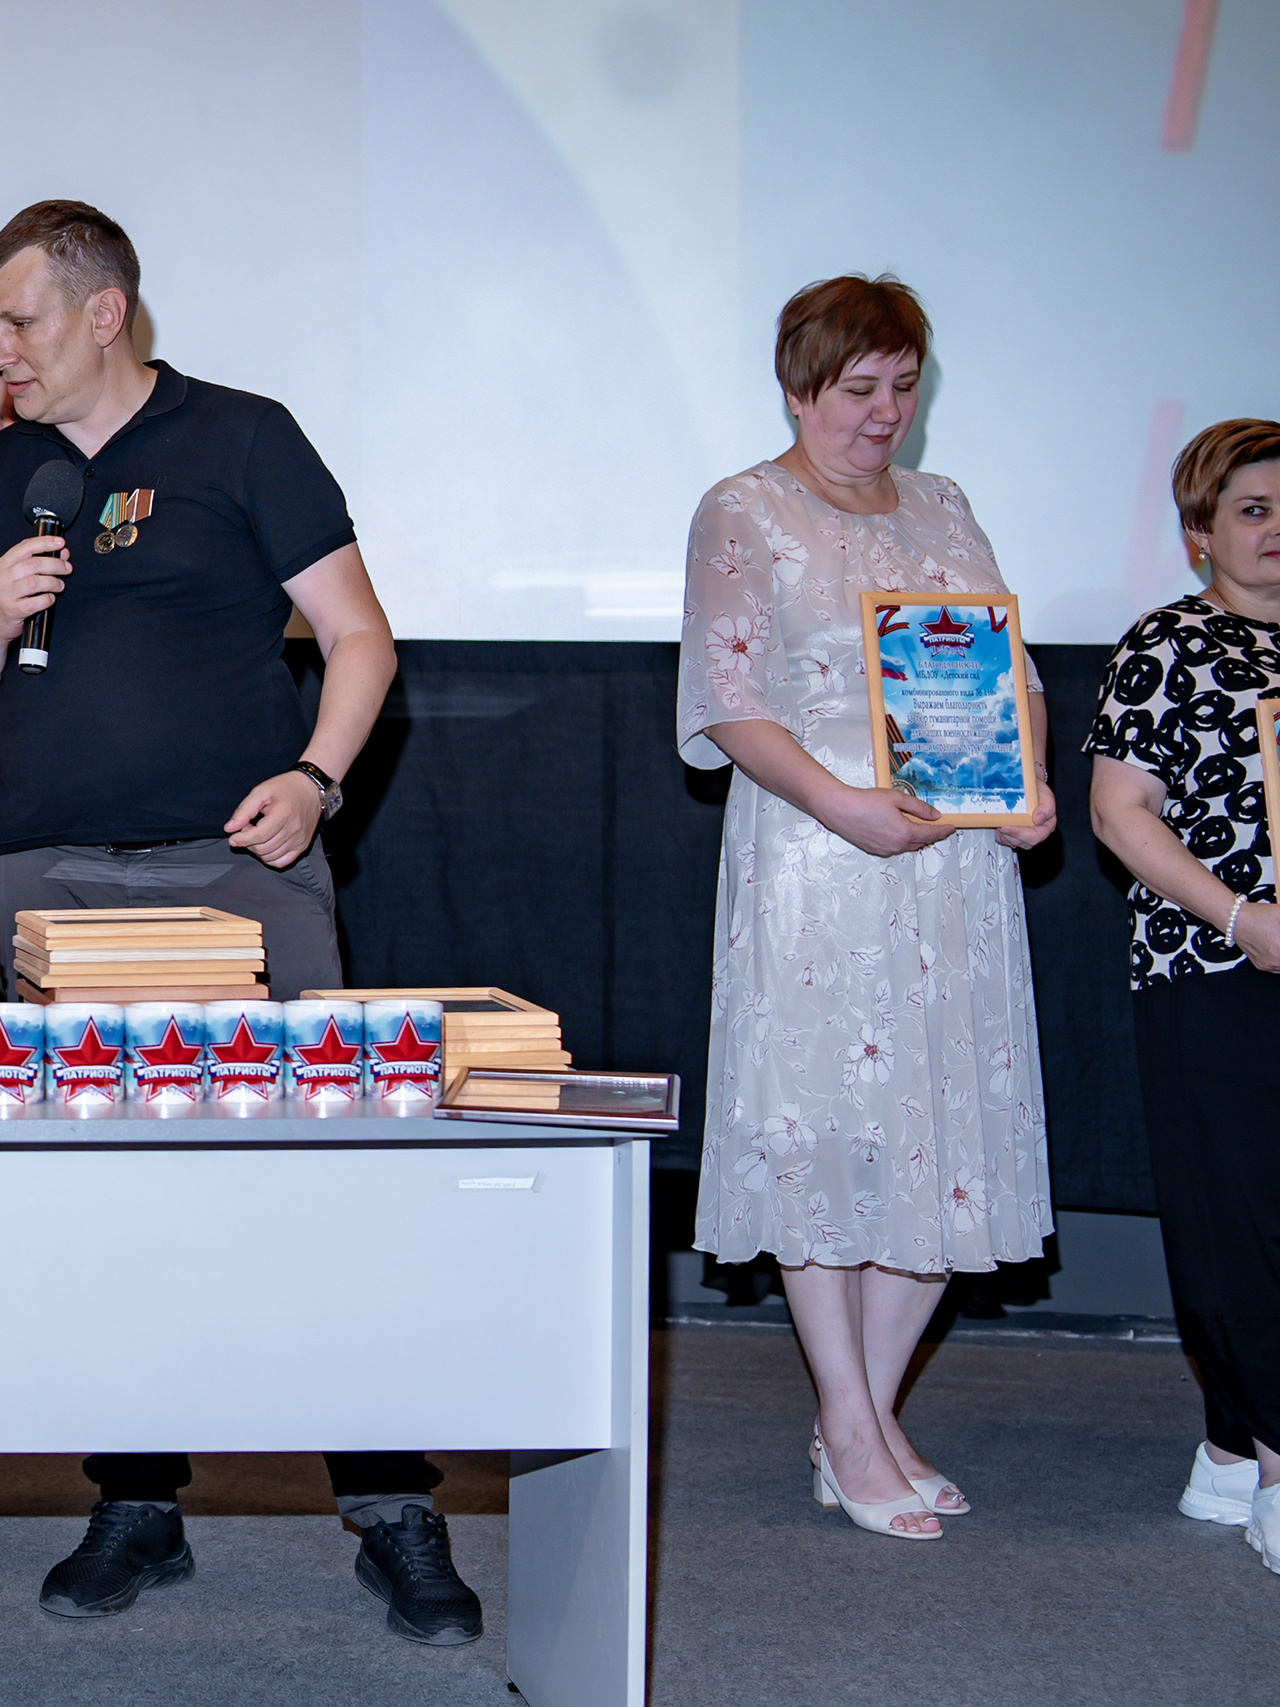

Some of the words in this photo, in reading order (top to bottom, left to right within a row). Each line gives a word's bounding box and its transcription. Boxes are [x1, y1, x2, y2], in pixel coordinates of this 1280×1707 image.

[918, 661, 980, 670] БЛАГОДАРНОСТЬ
[915, 670, 939, 680] МБДОУ
[970, 672, 980, 680] сад
[913, 698, 944, 712] Выражаем
[945, 699, 988, 712] благодарность
[63, 1068, 117, 1080] ПАТРИОТЫ
[144, 1067, 198, 1080] ПАТРИОТЫ
[215, 1065, 270, 1077] ПАТРИОТЫ
[304, 1066, 357, 1078] ПАТРИОТЫ
[380, 1064, 435, 1076] ПАТРИОТЫ
